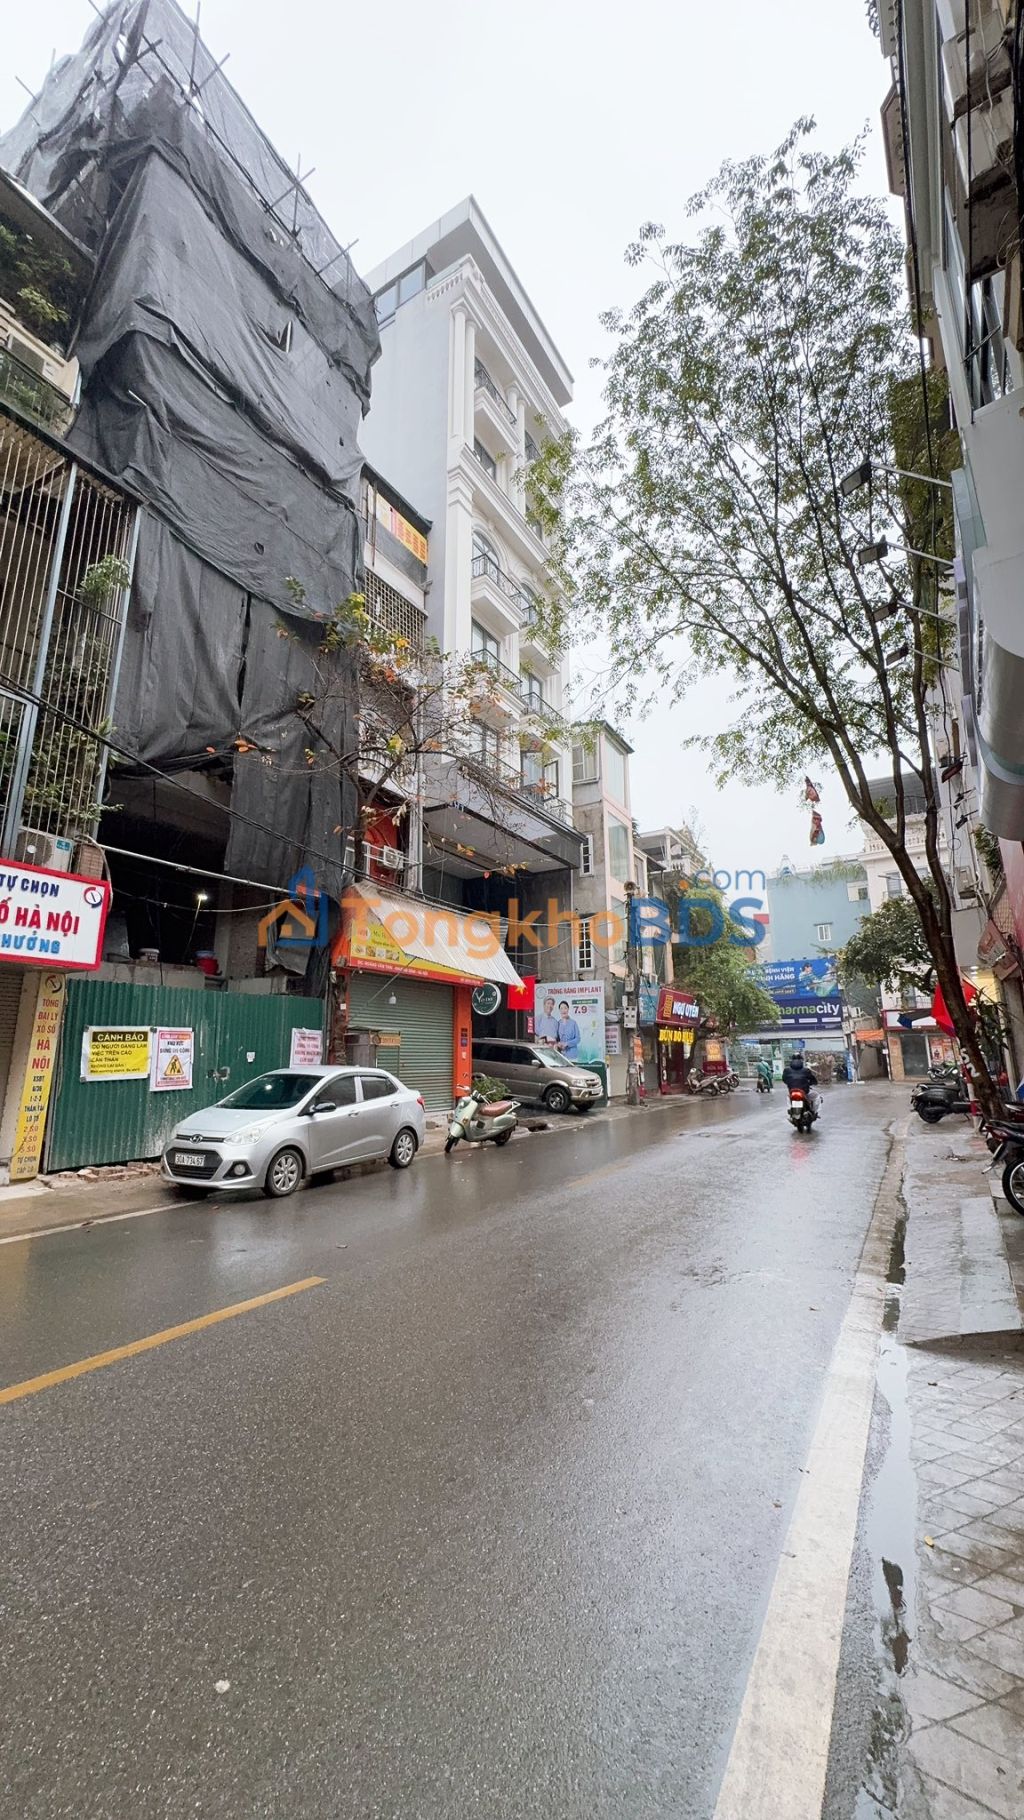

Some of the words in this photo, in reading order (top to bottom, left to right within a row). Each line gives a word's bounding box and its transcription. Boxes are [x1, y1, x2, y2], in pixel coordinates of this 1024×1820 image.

[20, 878, 60, 898] CHỌN
[14, 903, 41, 929] HÀ
[46, 910, 80, 937] NỘI
